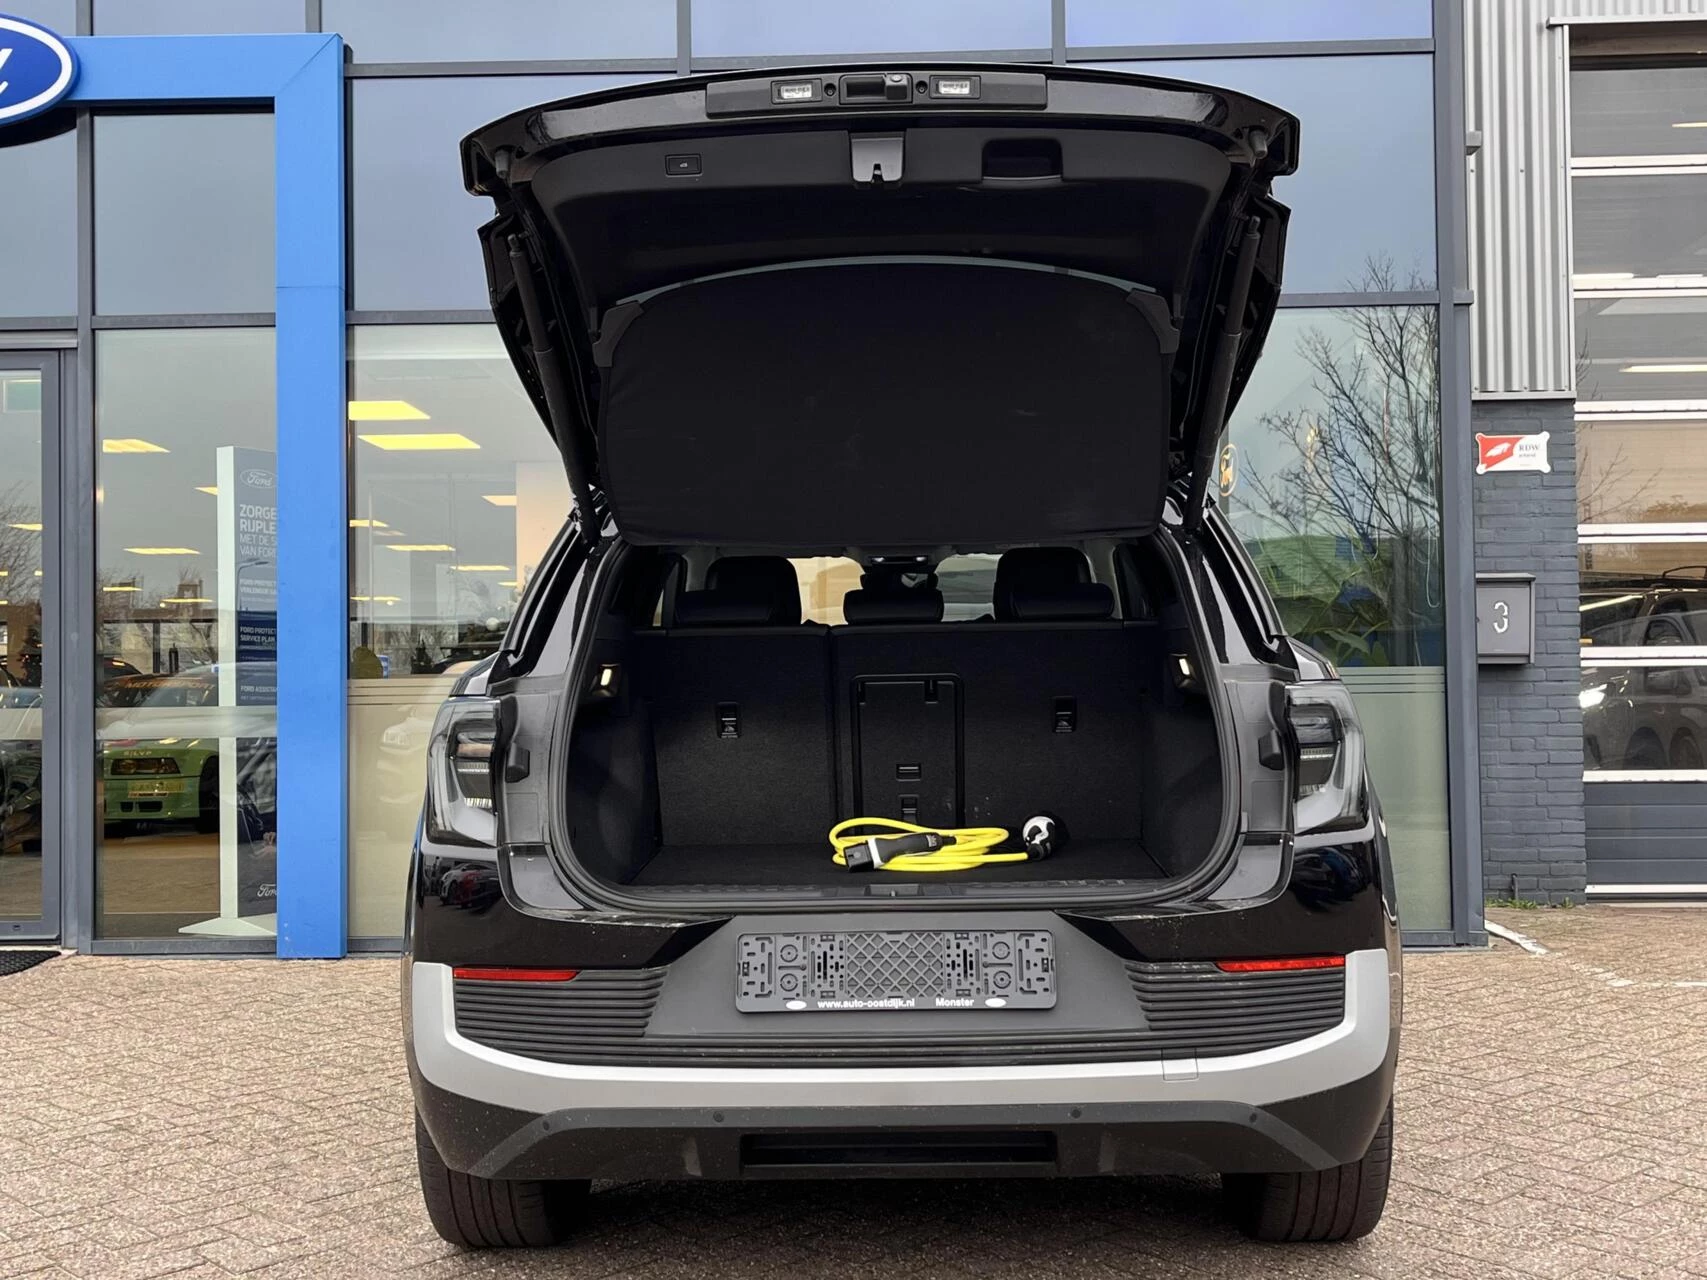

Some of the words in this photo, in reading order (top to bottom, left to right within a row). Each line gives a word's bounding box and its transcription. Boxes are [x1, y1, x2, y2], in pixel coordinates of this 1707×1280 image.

[1519, 444, 1539, 452] RDW
[247, 471, 272, 486] Ford
[240, 504, 277, 520] ZORGE
[240, 519, 277, 534] RIJPLE
[240, 533, 257, 544] MET
[259, 535, 269, 546] DE
[240, 545, 256, 556] VAN
[1494, 602, 1508, 633] 3
[240, 626, 254, 634] FORD
[817, 998, 915, 1009] www.auto-oostdijk.nl
[936, 998, 974, 1007] Monster
